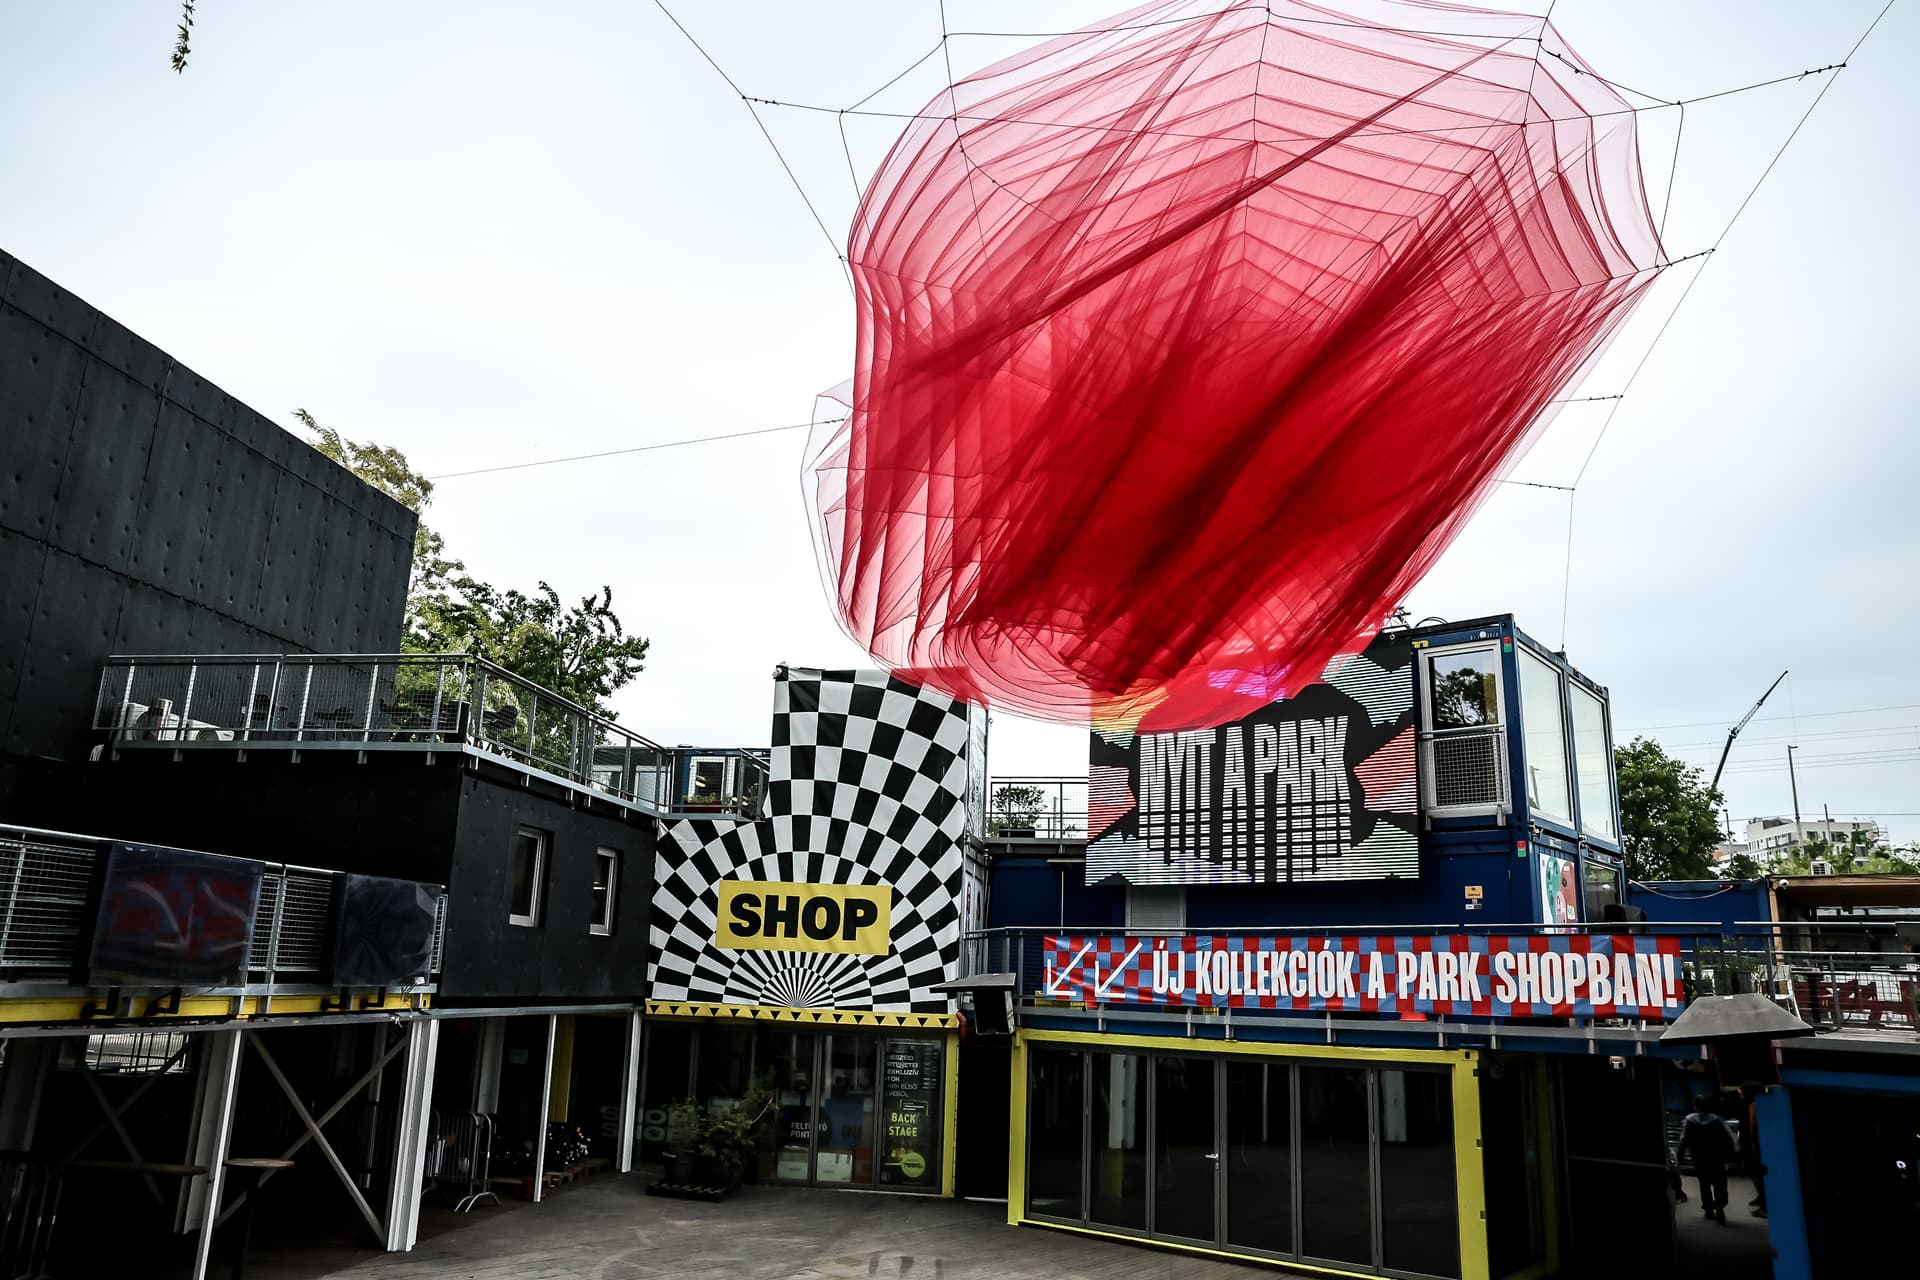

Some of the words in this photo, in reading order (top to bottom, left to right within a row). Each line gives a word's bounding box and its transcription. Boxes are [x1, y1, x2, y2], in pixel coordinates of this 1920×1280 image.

[1139, 728, 1216, 848] NYIT
[1222, 726, 1247, 862] A
[1254, 715, 1352, 866] PARK
[728, 893, 878, 941] SHOP
[1152, 940, 1185, 994] ÚJ
[1195, 940, 1356, 999] KOLLEKCIÓK
[1367, 951, 1386, 999] A
[1397, 951, 1482, 1002] PARK
[1495, 951, 1678, 1008] SHOPBAN!
[888, 1126, 918, 1137] STAGE
[891, 1112, 917, 1124] BACK
